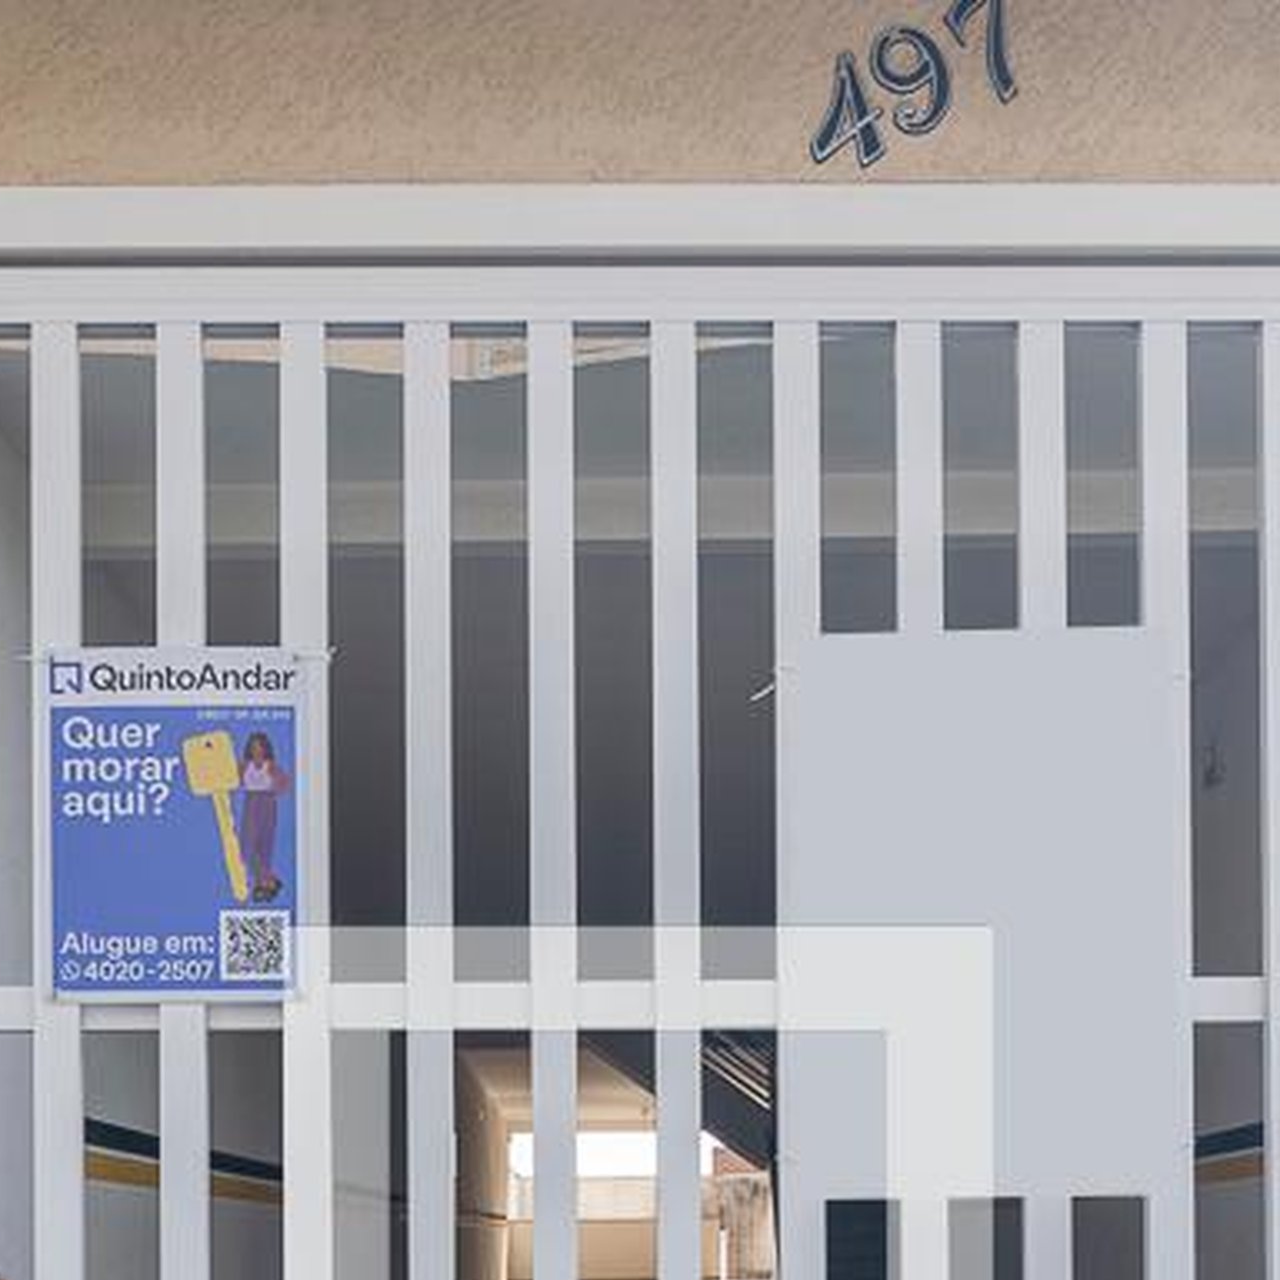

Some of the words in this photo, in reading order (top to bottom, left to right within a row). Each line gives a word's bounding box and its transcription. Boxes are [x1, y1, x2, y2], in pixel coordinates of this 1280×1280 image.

[810, 0, 1017, 167] 497
[89, 663, 296, 693] QuintoAndar
[62, 715, 161, 750] Quer
[62, 755, 180, 782] morar
[62, 783, 170, 823] aqui?
[59, 932, 159, 961] Alugue
[164, 935, 215, 954] em:
[83, 960, 215, 982] 4020-2507
